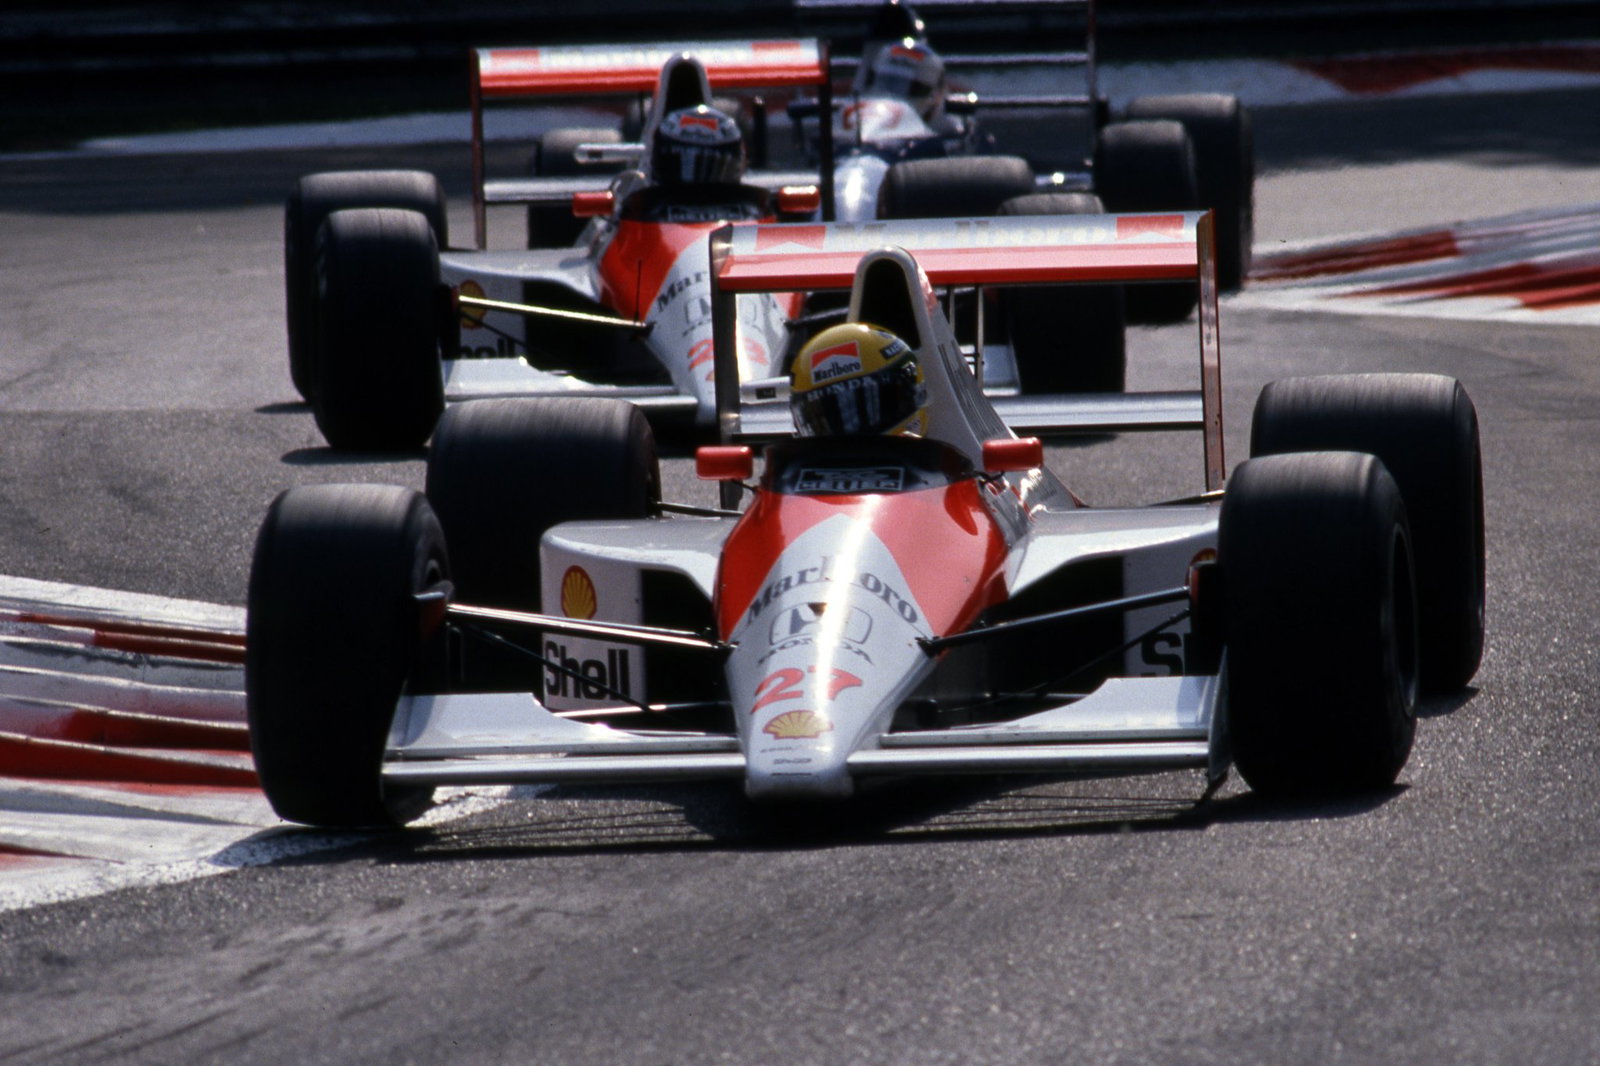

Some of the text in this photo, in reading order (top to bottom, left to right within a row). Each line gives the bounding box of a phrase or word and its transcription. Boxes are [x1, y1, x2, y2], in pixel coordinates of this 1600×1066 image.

[813, 361, 862, 384] Marlboro
[544, 640, 631, 701] Shell
[750, 665, 864, 715] 27
